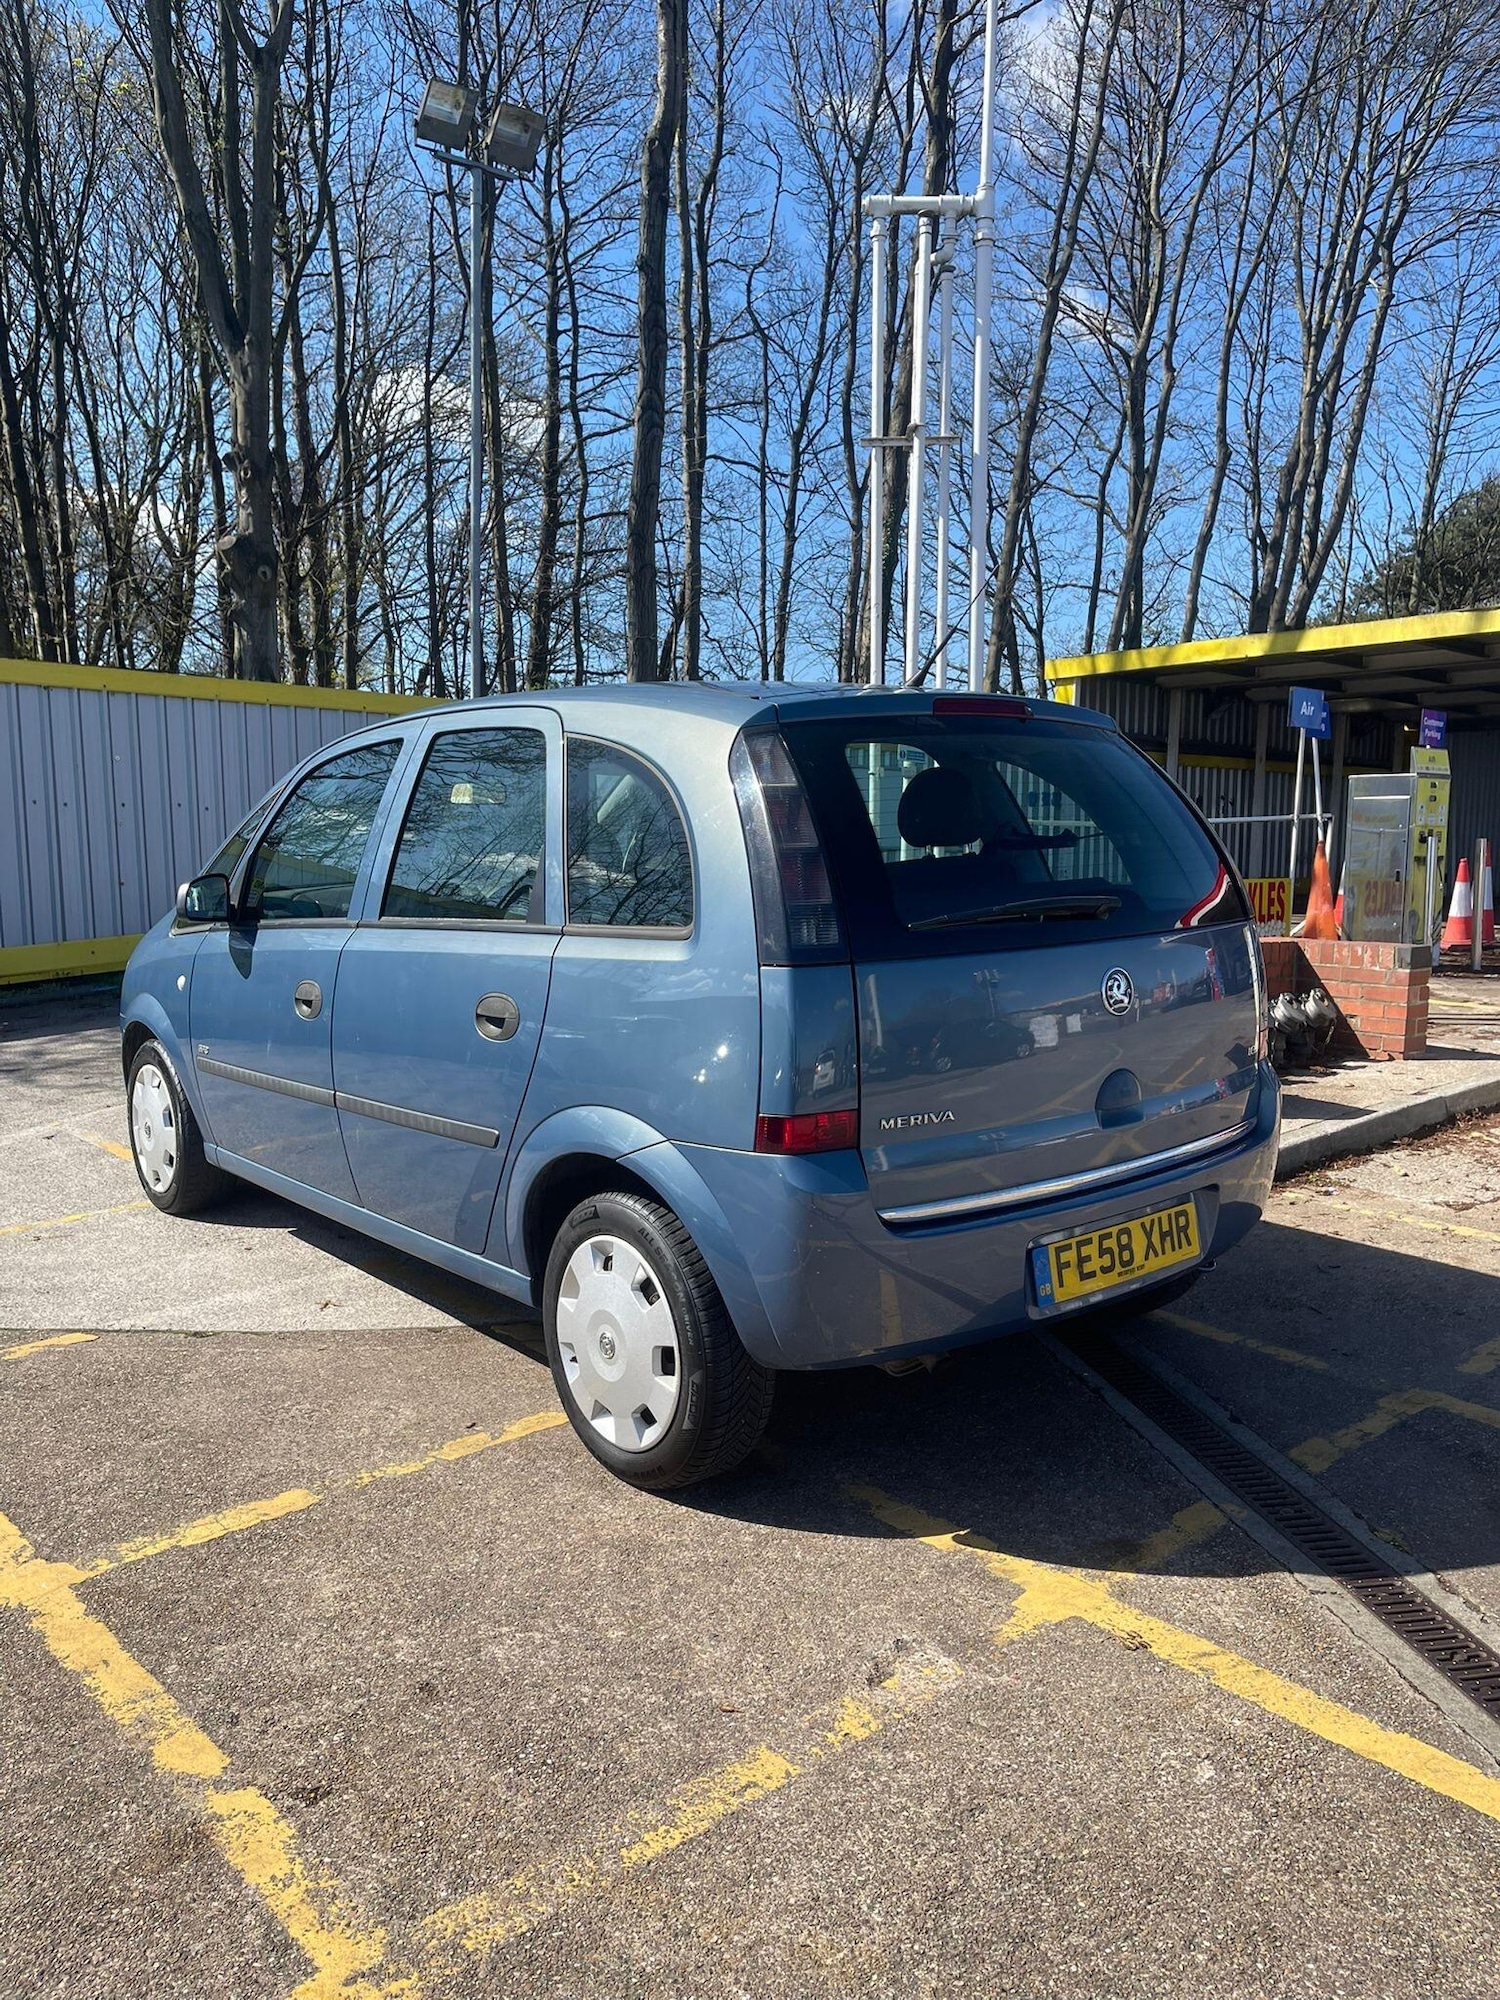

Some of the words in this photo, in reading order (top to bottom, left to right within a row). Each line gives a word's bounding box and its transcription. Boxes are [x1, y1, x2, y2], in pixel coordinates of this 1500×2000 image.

[1300, 701, 1315, 716] Air
[880, 1110, 955, 1130] MERIVA
[637, 1227, 655, 1247] ALL
[1054, 1227, 1135, 1289] FE58
[1140, 1209, 1192, 1261] XHR
[1040, 1283, 1052, 1297] GB
